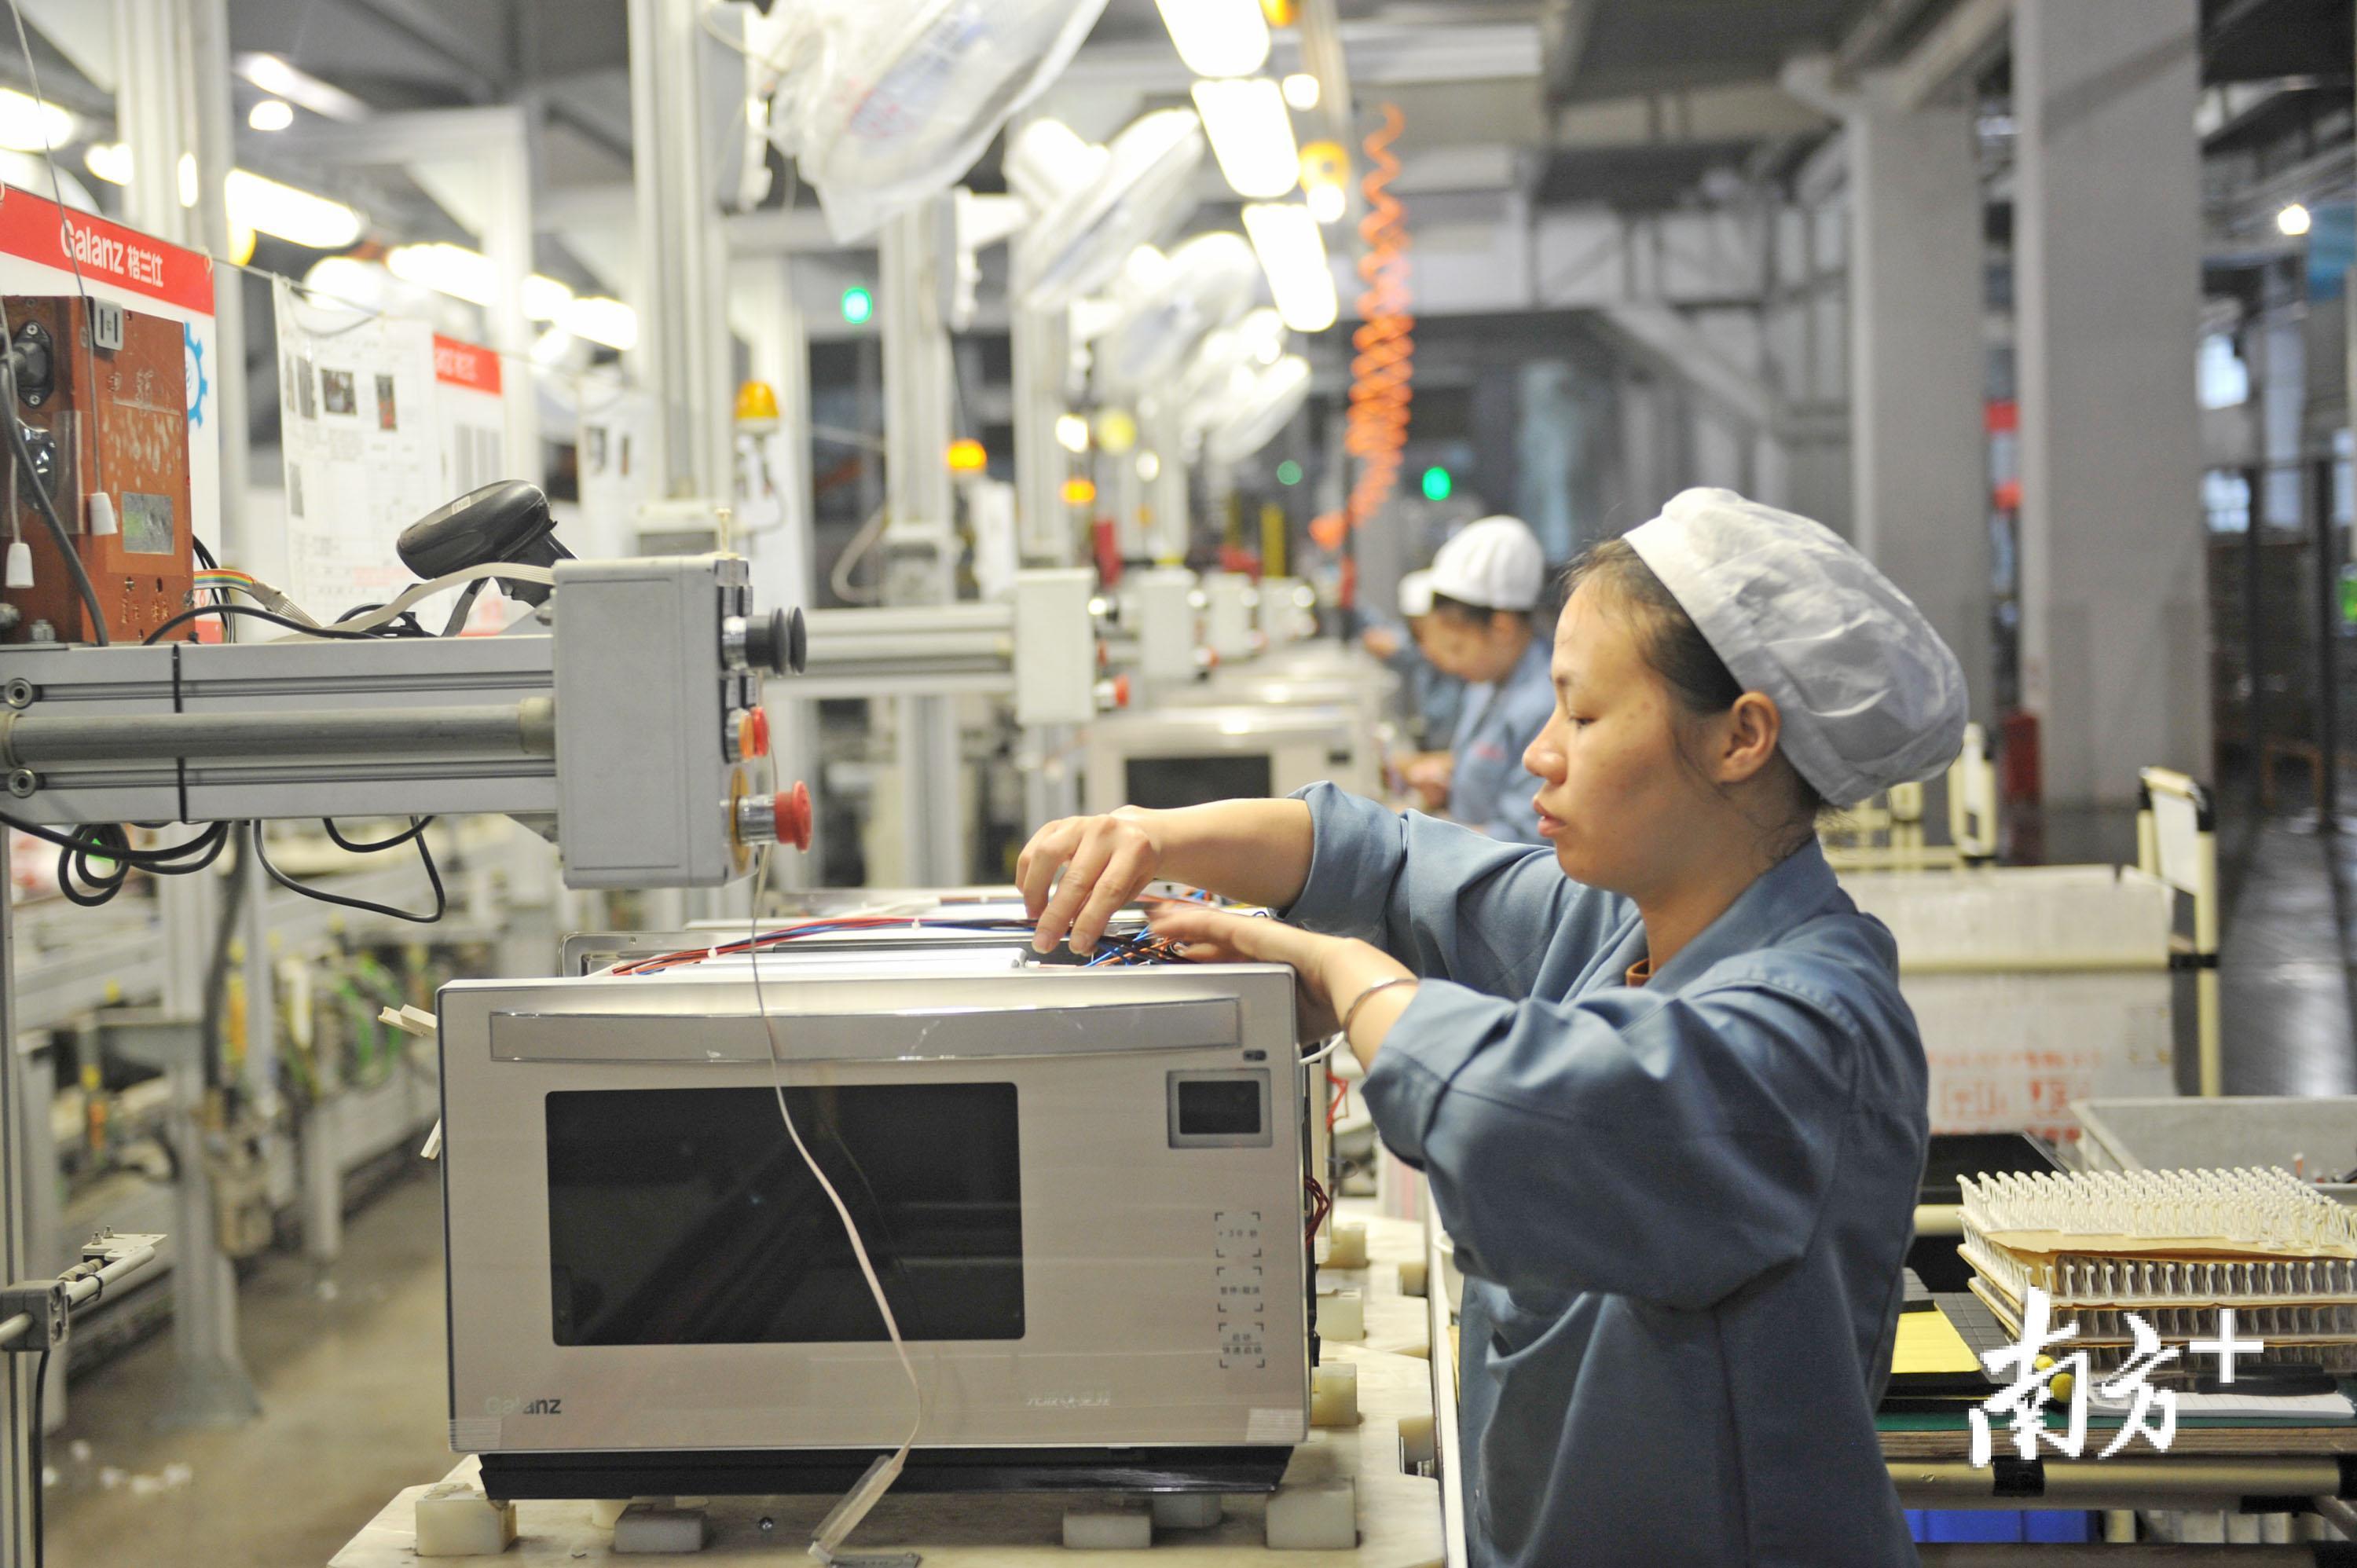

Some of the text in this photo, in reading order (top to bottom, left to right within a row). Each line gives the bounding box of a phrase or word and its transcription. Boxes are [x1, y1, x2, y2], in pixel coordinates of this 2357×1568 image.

[60, 219, 163, 288] Galanz 格兰仕
